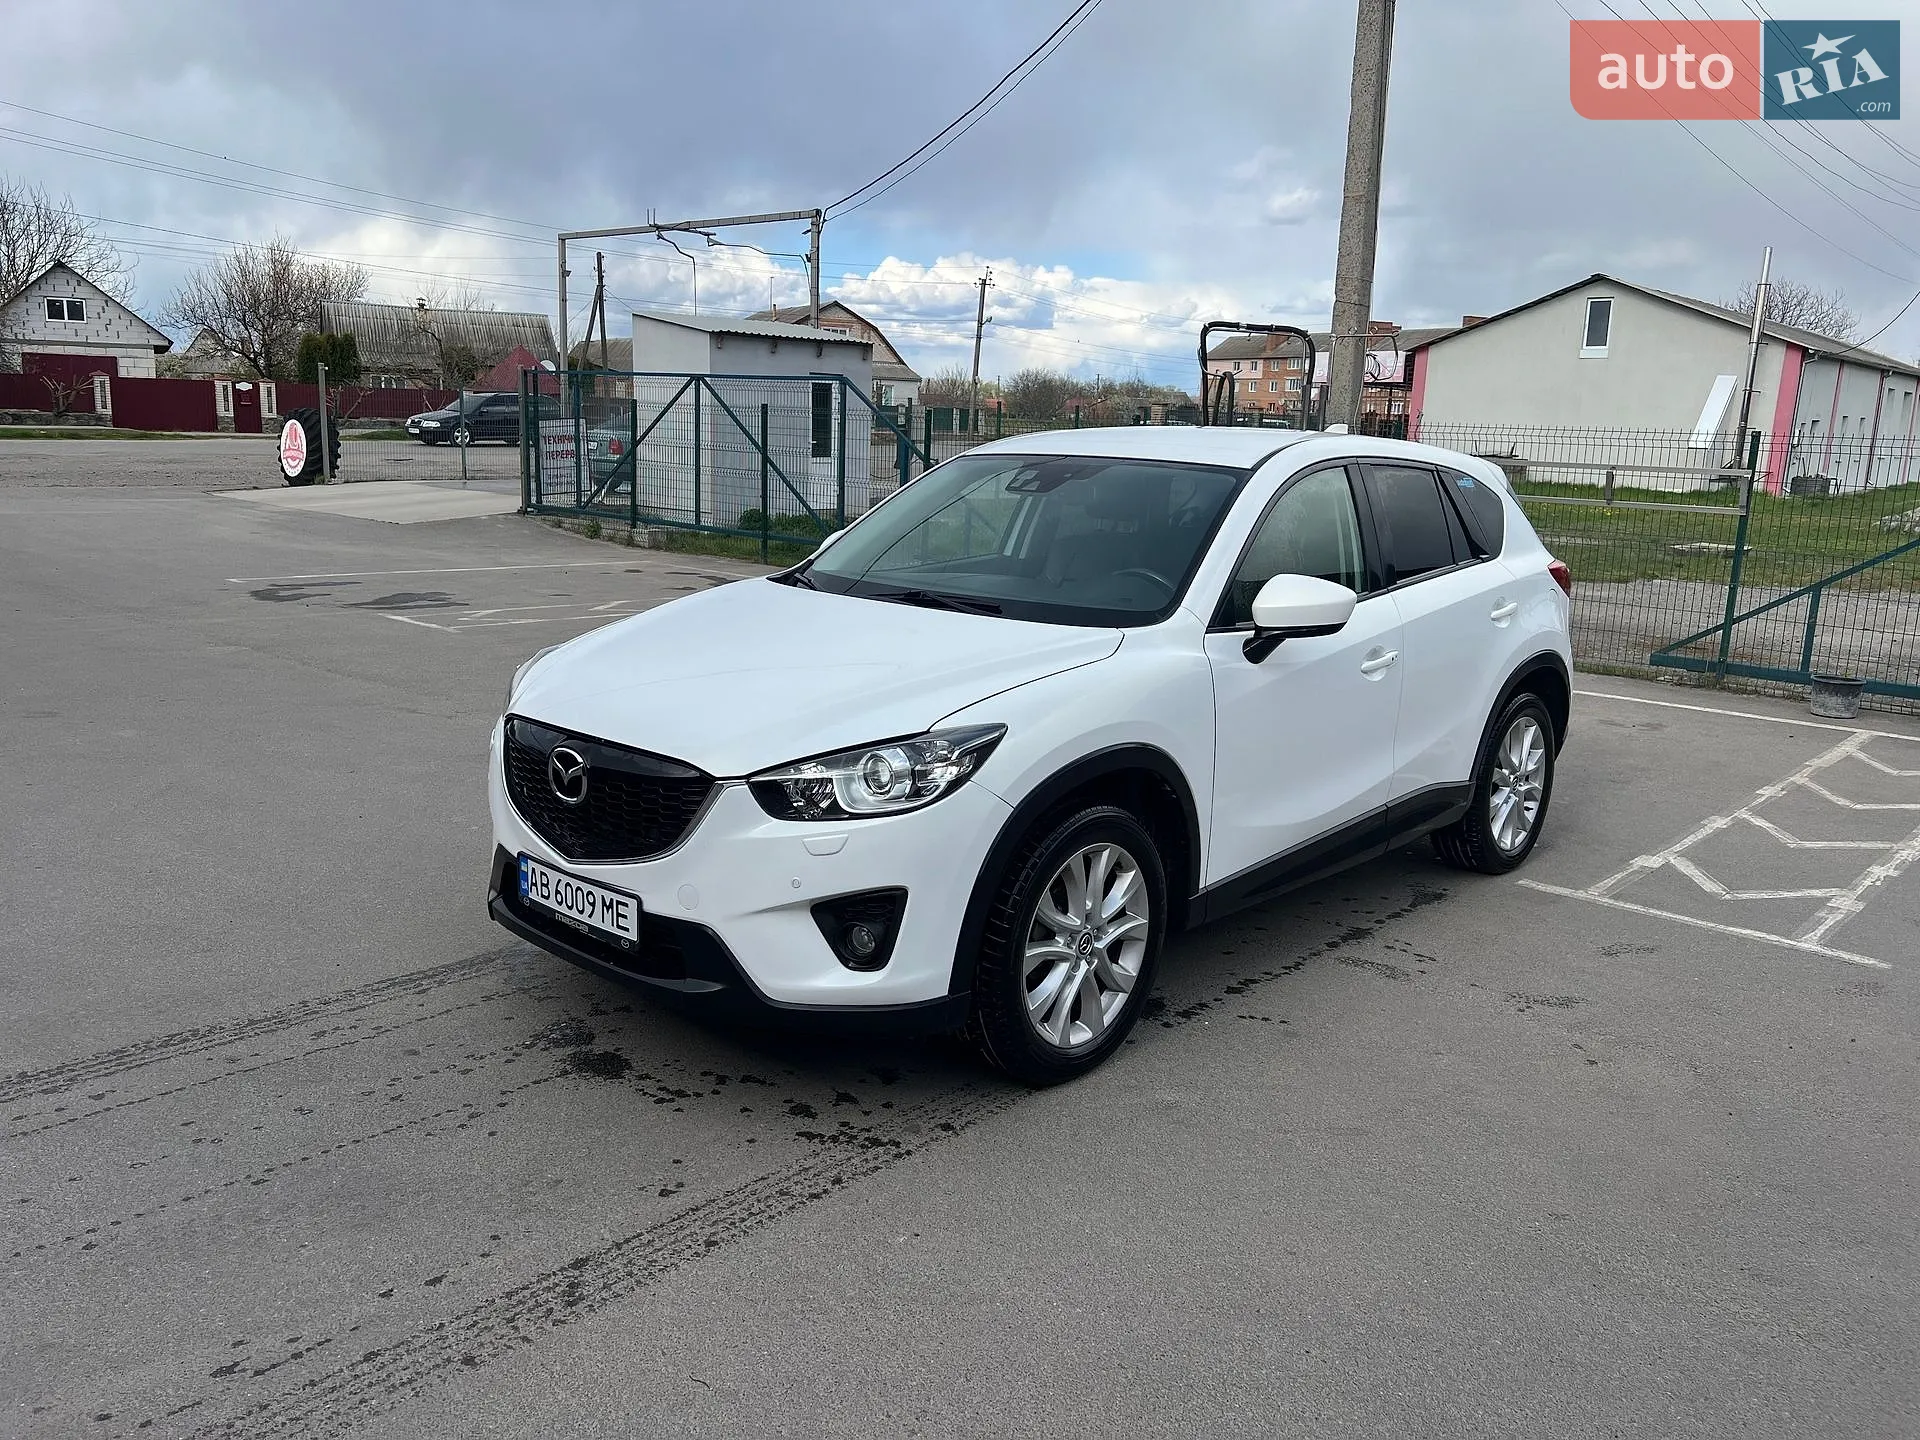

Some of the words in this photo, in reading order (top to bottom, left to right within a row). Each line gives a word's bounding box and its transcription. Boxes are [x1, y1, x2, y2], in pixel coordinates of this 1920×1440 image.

[545, 449, 576, 460] ПЕРЕРВ
[530, 867, 550, 900] AB
[555, 879, 596, 918] 6009
[602, 895, 630, 932] ME
